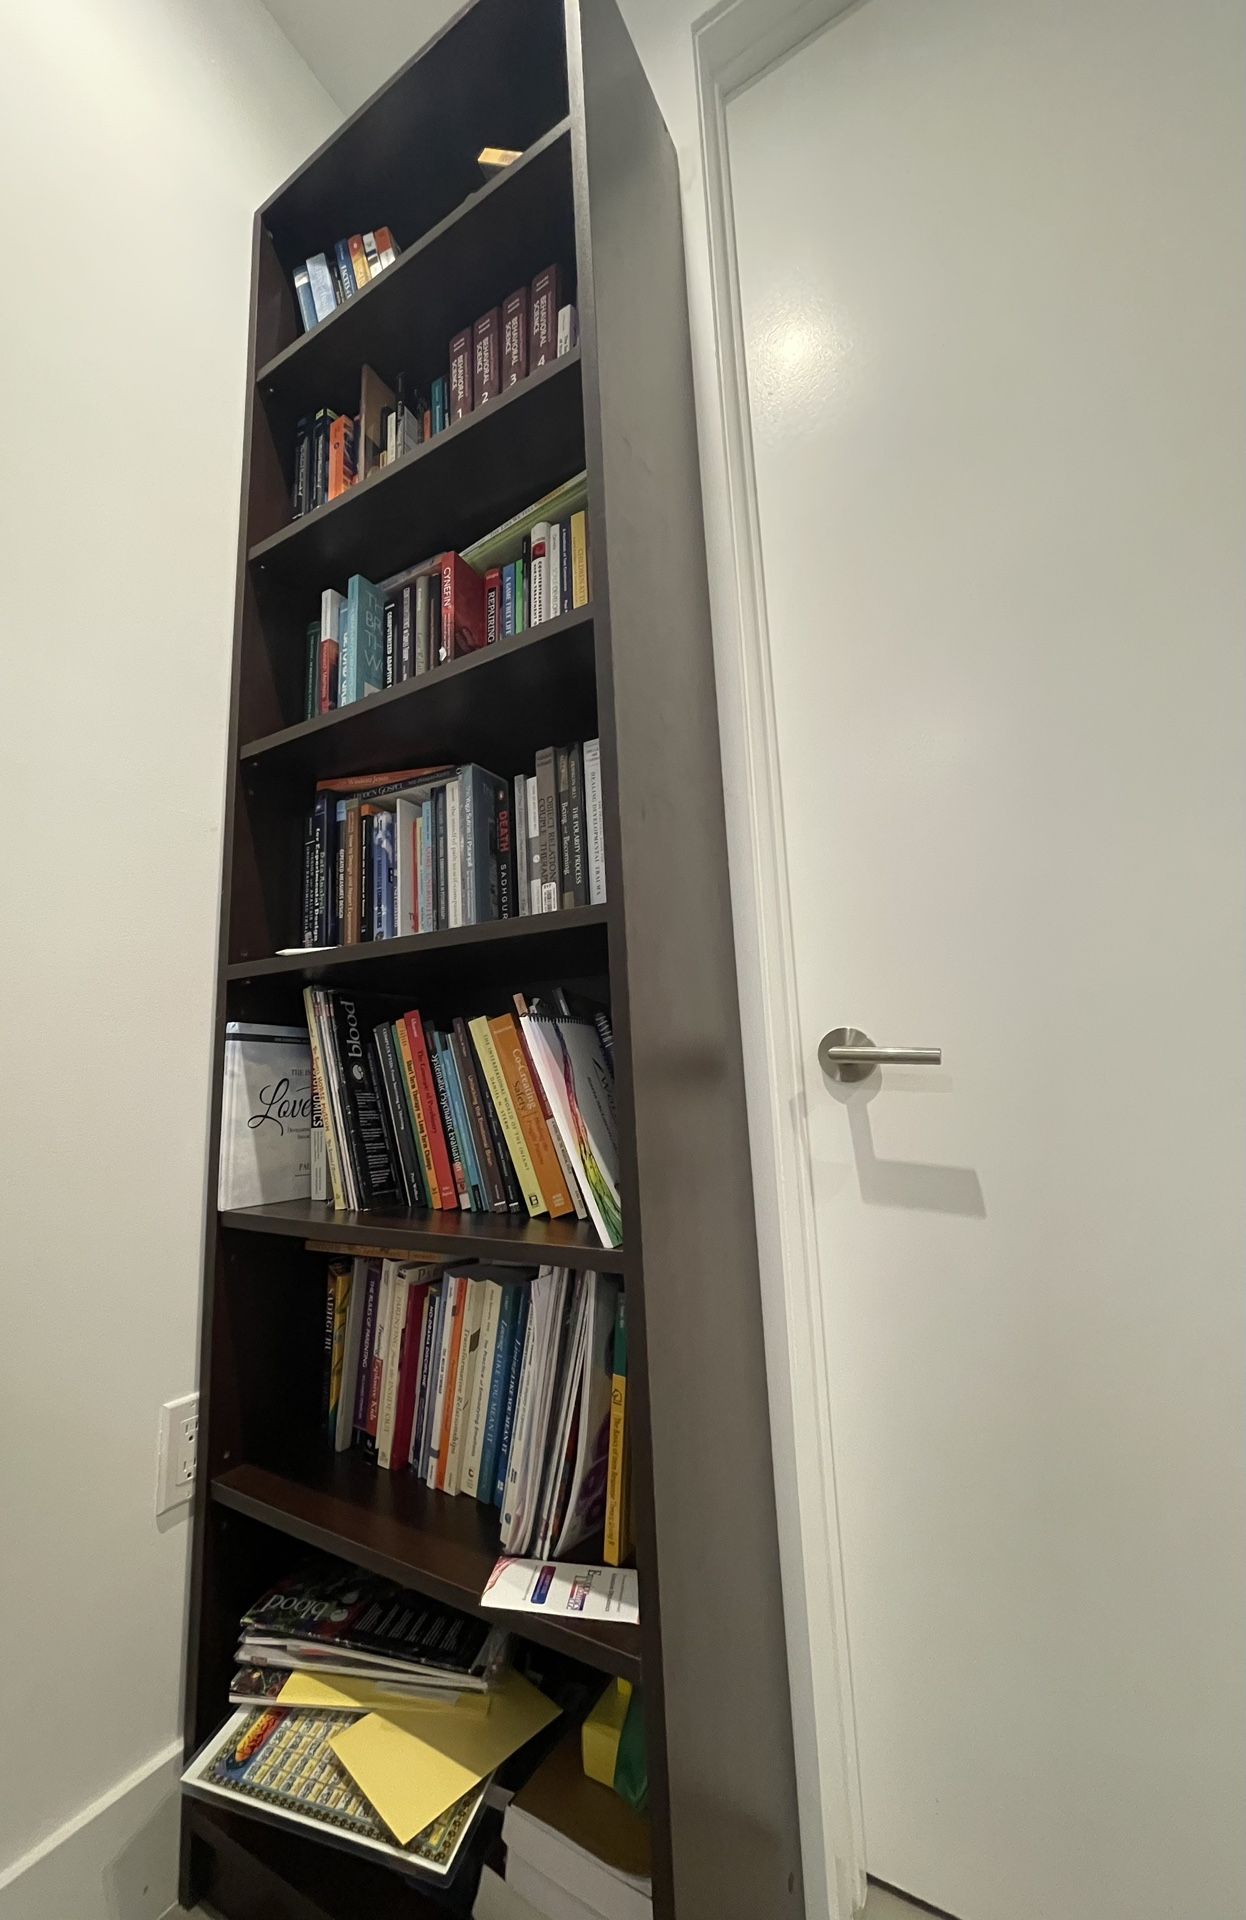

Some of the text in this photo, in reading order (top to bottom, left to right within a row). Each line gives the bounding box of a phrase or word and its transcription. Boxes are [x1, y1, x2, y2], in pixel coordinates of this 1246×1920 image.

[537, 354, 545, 367] 4
[482, 392, 488, 404] 2
[510, 374, 517, 386] 3
[457, 408, 462, 418] 1
[487, 591, 495, 643] REPAIRING
[500, 810, 509, 852] DEATH
[546, 796, 554, 829] OBJECT
[560, 802, 570, 875] Being Becoming
[572, 821, 580, 853] POLARITY
[591, 804, 600, 863] DEVELOPMENTAL
[340, 1000, 362, 1057] blood
[512, 1048, 537, 1110] Co-Creating
[512, 1081, 526, 1111] Safety
[247, 1077, 312, 1136] Love
[431, 1054, 445, 1091] Systematic
[439, 1093, 453, 1130] Psychiatric
[448, 1133, 463, 1172] Evaluation
[468, 1075, 478, 1105] Unlocking
[478, 1117, 488, 1148] Emotional
[485, 1149, 493, 1167] Brain
[488, 1048, 505, 1095] INTERPERSONAL
[504, 1098, 514, 1120] WORLD
[510, 1122, 517, 1130] OF
[514, 1133, 522, 1146] THE
[519, 1147, 530, 1171] INFANT
[489, 1077, 499, 1099] DANIEL
[500, 1110, 509, 1130] STERN
[410, 1090, 419, 1112] Therapy
[424, 1150, 432, 1170] Change
[324, 1288, 334, 1351] SADHGURU
[366, 1317, 372, 1327] OF
[391, 1296, 402, 1348] PARENTING
[362, 1329, 371, 1367] PARENTING
[422, 1305, 434, 1387] NO-DRAMA DISCIPLINE
[510, 1338, 521, 1374] Living
[370, 1359, 381, 1397] Explosive
[385, 1380, 394, 1410] INSIDE
[450, 1328, 470, 1455] Transformative Relationships
[487, 1320, 508, 1444] Loving LIKE YOU MEAN IT
[474, 1387, 484, 1424] Embodying
[472, 1426, 480, 1456] Emotions
[503, 1416, 511, 1440] MEAN
[501, 1444, 507, 1454] IT
[613, 1448, 620, 1456] of
[609, 1472, 618, 1499] Response
[260, 1594, 330, 1621] blood
